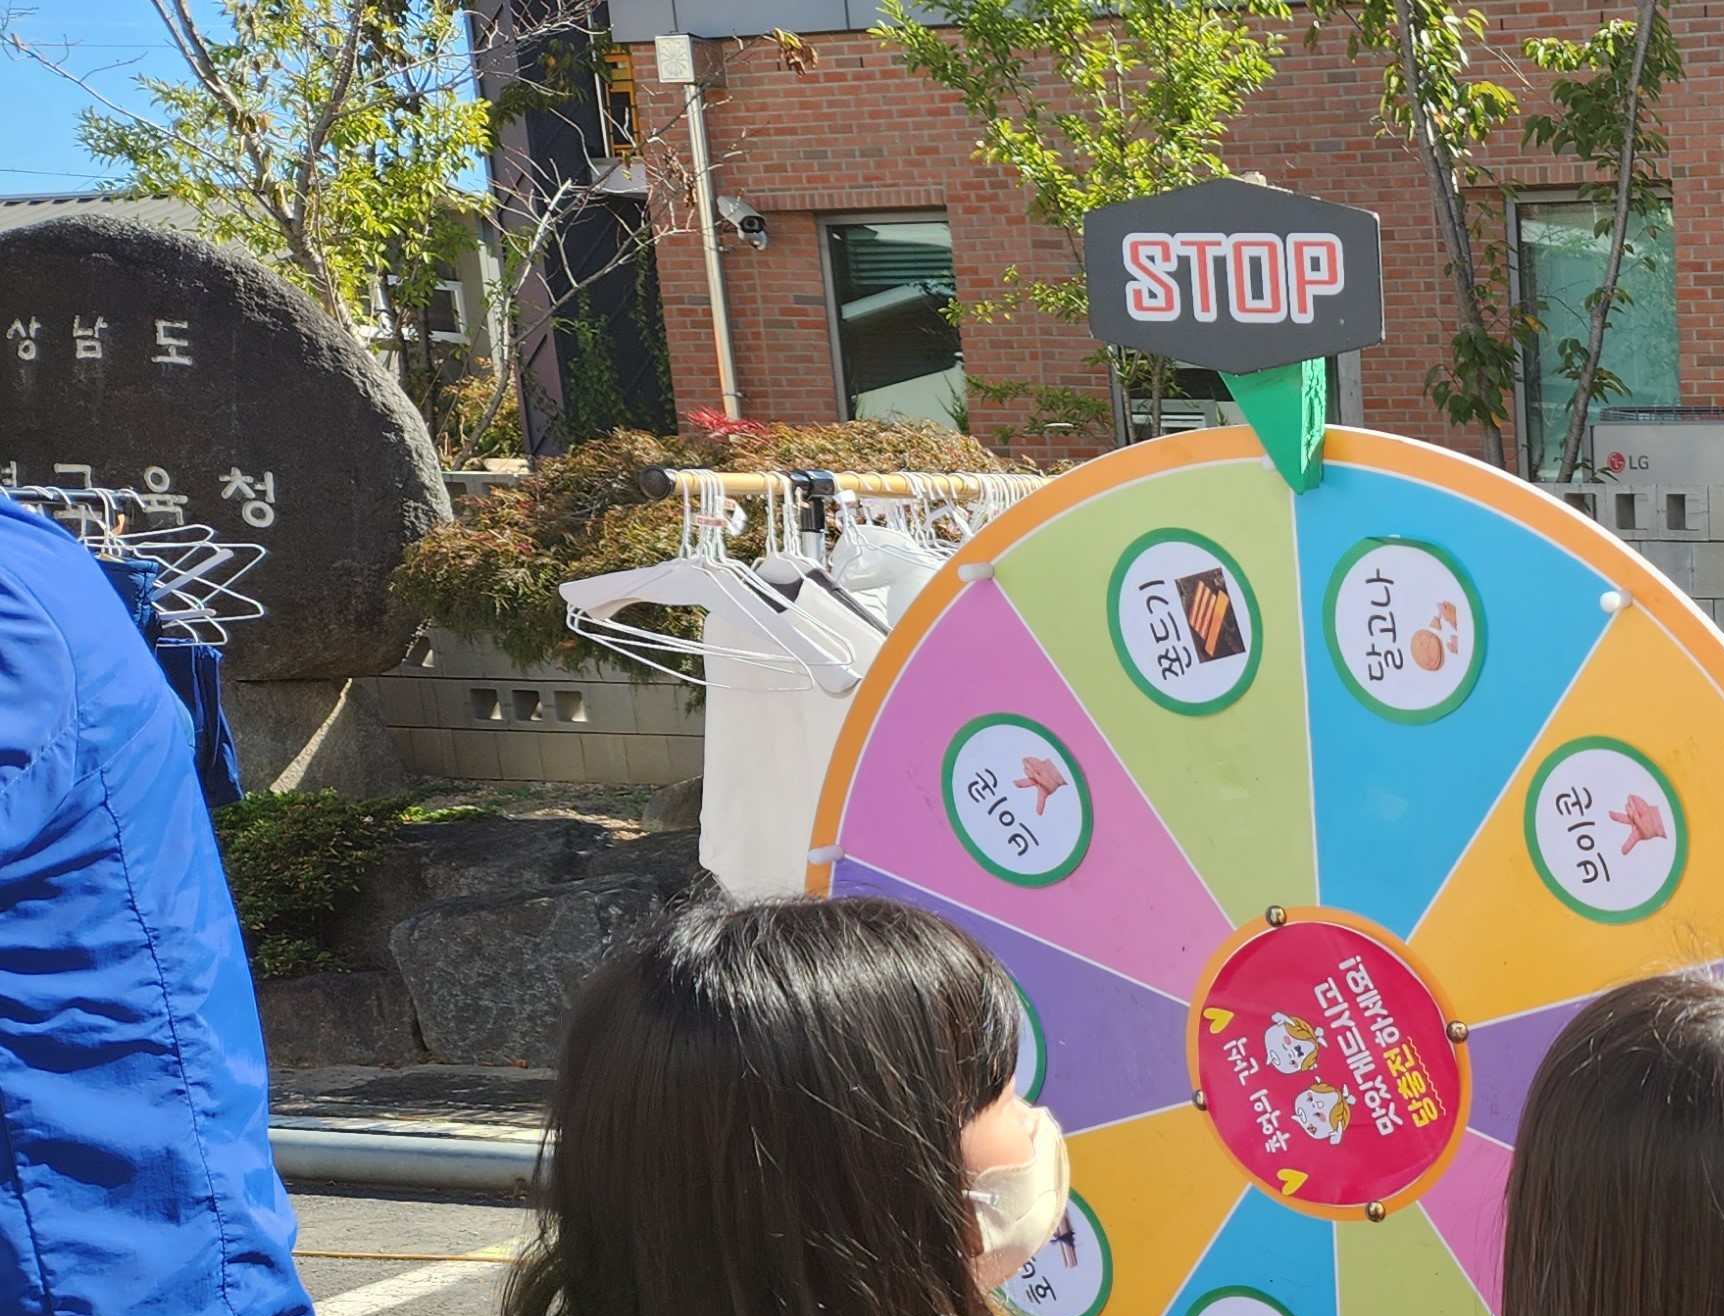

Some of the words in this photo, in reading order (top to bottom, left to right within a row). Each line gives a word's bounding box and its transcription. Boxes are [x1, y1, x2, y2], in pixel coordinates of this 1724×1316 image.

[1122, 232, 1345, 324] STOP
[1628, 455, 1650, 471] LG
[1138, 579, 1192, 681] 쫀드기
[1364, 567, 1404, 682] 달고나
[967, 767, 1040, 857] 브이콘
[1555, 785, 1611, 884] 브이콘
[1222, 1036, 1260, 1087] 간식
[1249, 1088, 1291, 1154] 추억의
